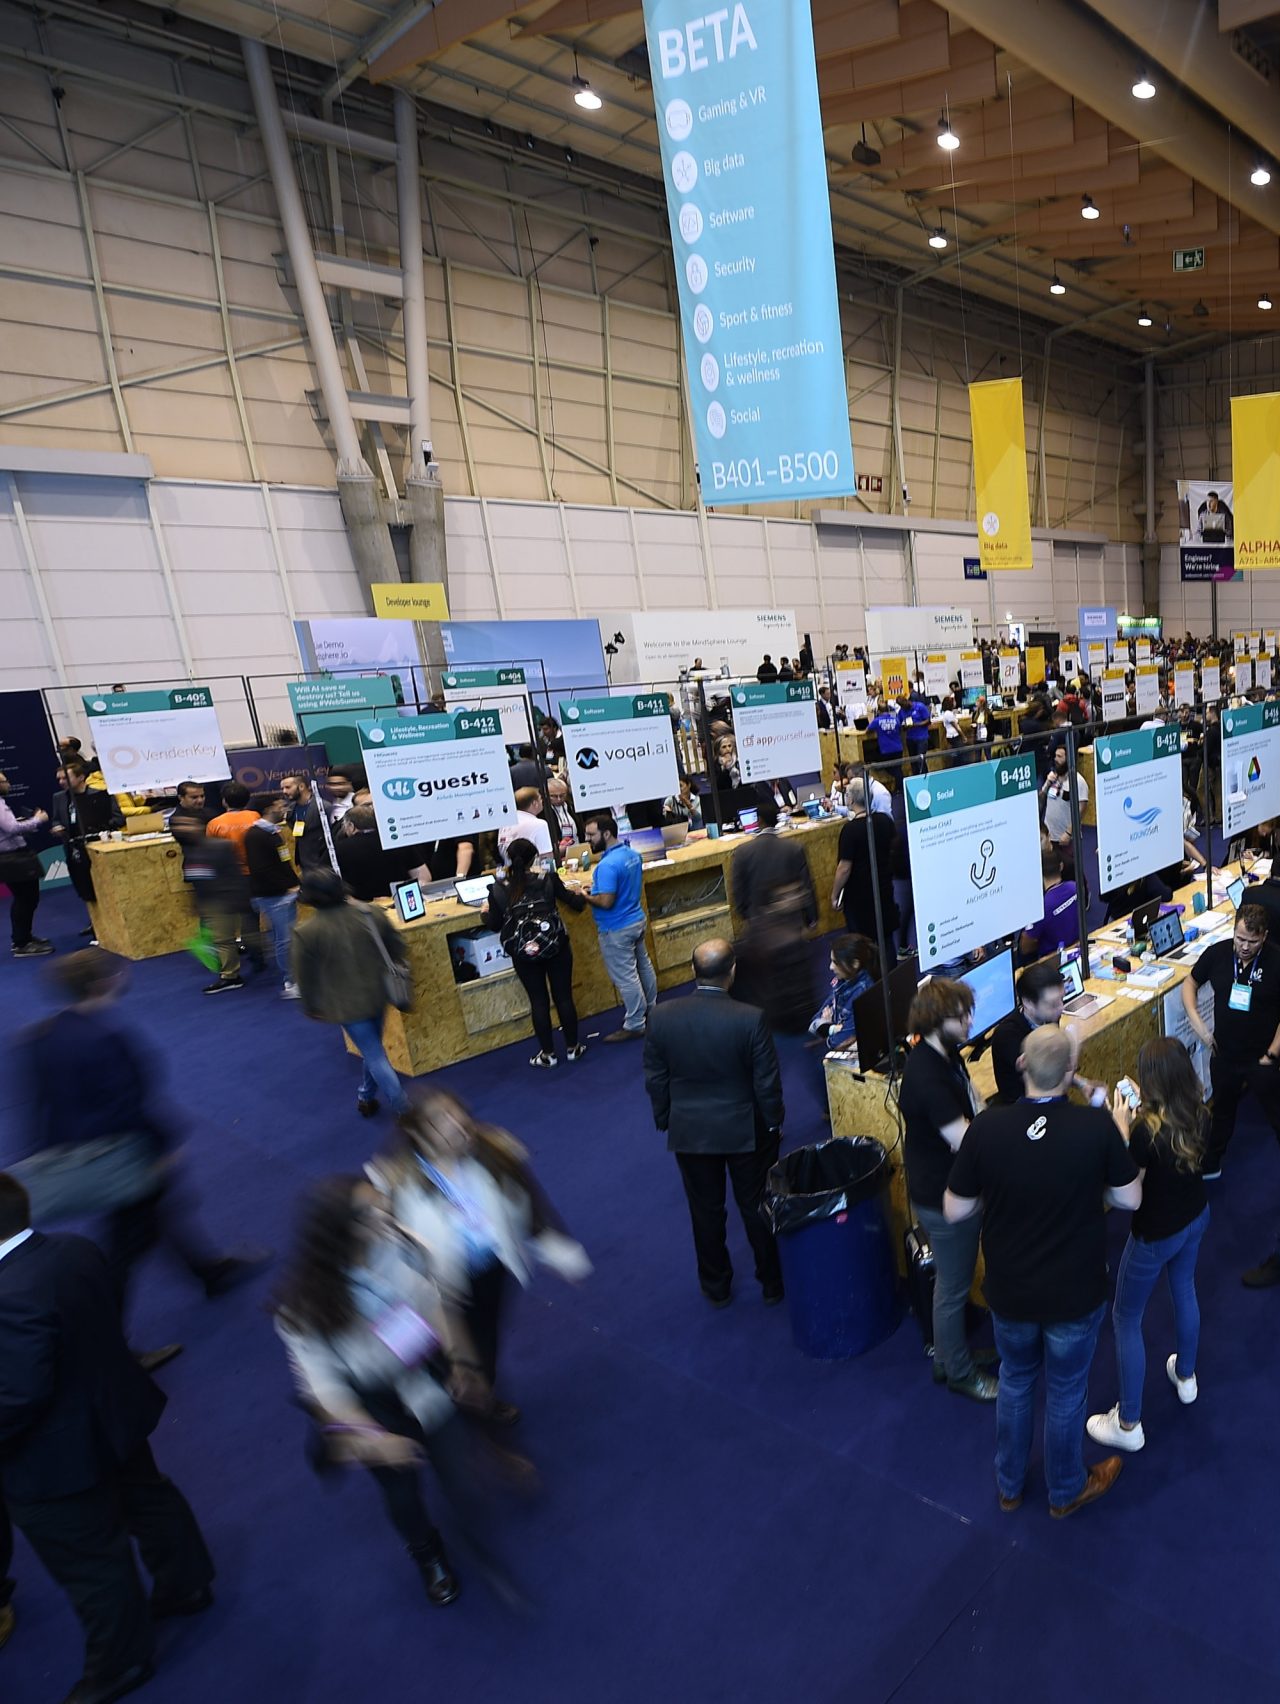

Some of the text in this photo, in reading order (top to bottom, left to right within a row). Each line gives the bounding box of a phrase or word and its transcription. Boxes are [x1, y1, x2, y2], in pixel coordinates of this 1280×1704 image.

[658, 2, 758, 79] BETA
[699, 86, 767, 123] Gaming & VR
[704, 153, 744, 177] Big data
[709, 205, 755, 229] Software
[715, 256, 755, 277] Security
[720, 301, 793, 329] Sport & fitness
[724, 339, 824, 369] Lifestyle, recreation
[726, 366, 780, 386] & wellness
[731, 407, 760, 424] Social
[984, 541, 1008, 551] Big data
[1185, 553, 1212, 562] Engineer?
[386, 597, 431, 609] Developer lounge
[756, 614, 786, 622] SIEMENS
[934, 615, 963, 624] SIEMENS
[324, 641, 344, 649] Demo
[643, 641, 672, 649] Welcome
[295, 686, 310, 694] Will
[311, 685, 319, 693] AI
[297, 693, 324, 702] destroy
[325, 691, 336, 699] us?
[339, 690, 350, 698] Tell
[789, 687, 810, 696] B-410
[174, 693, 206, 704] B-405
[298, 697, 366, 709] using #WebSummit
[637, 699, 664, 711] B-411
[390, 717, 494, 735] Lifestyle, Recreation B-412
[398, 732, 425, 740] Wellness
[1157, 733, 1177, 748] B-417
[140, 744, 217, 761] VendenKey
[604, 739, 669, 763] voqal.ai
[265, 766, 329, 781] Vendeney
[1001, 765, 1031, 786] B-418
[418, 772, 489, 797] guests
[1018, 780, 1031, 790] BETA
[936, 788, 954, 801] Social
